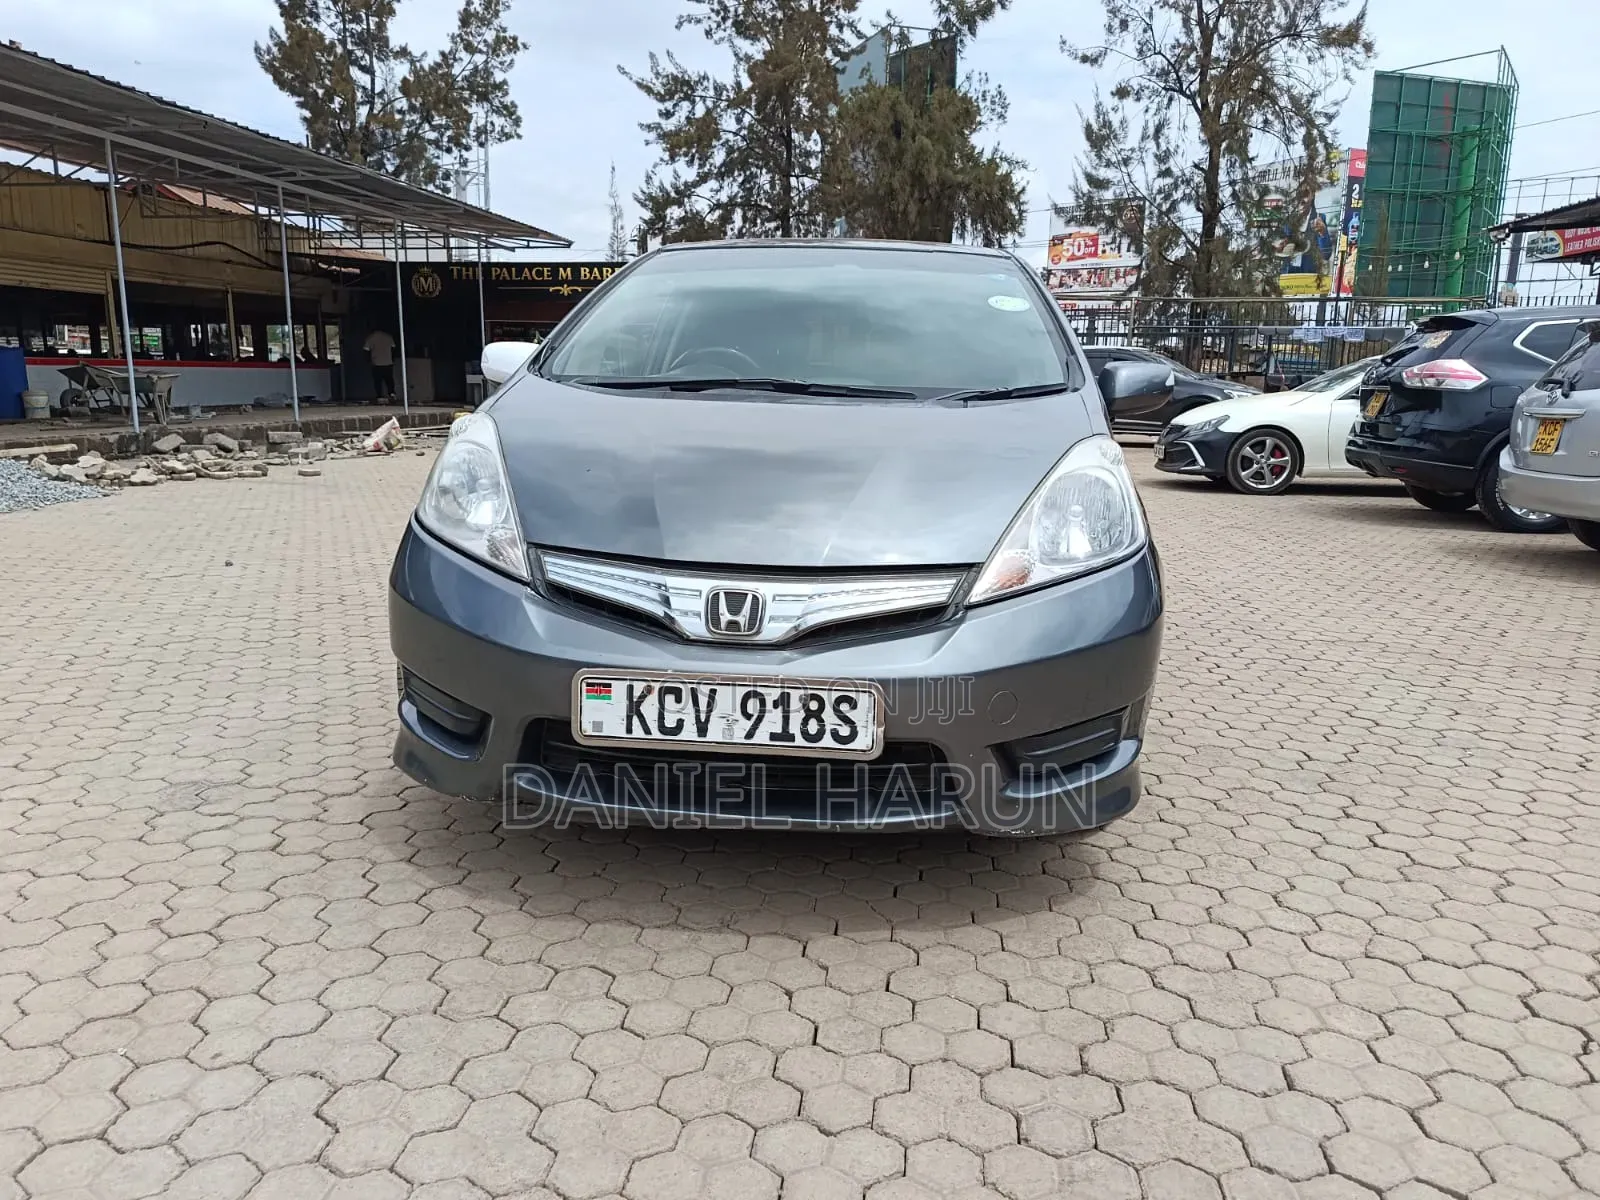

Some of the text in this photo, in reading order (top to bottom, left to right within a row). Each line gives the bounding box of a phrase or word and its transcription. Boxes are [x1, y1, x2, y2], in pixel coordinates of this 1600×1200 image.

[450, 266, 484, 281] THE
[491, 266, 552, 281] PALACE
[558, 267, 572, 281] M
[625, 683, 718, 738] KCV
[740, 689, 859, 746] 918S
